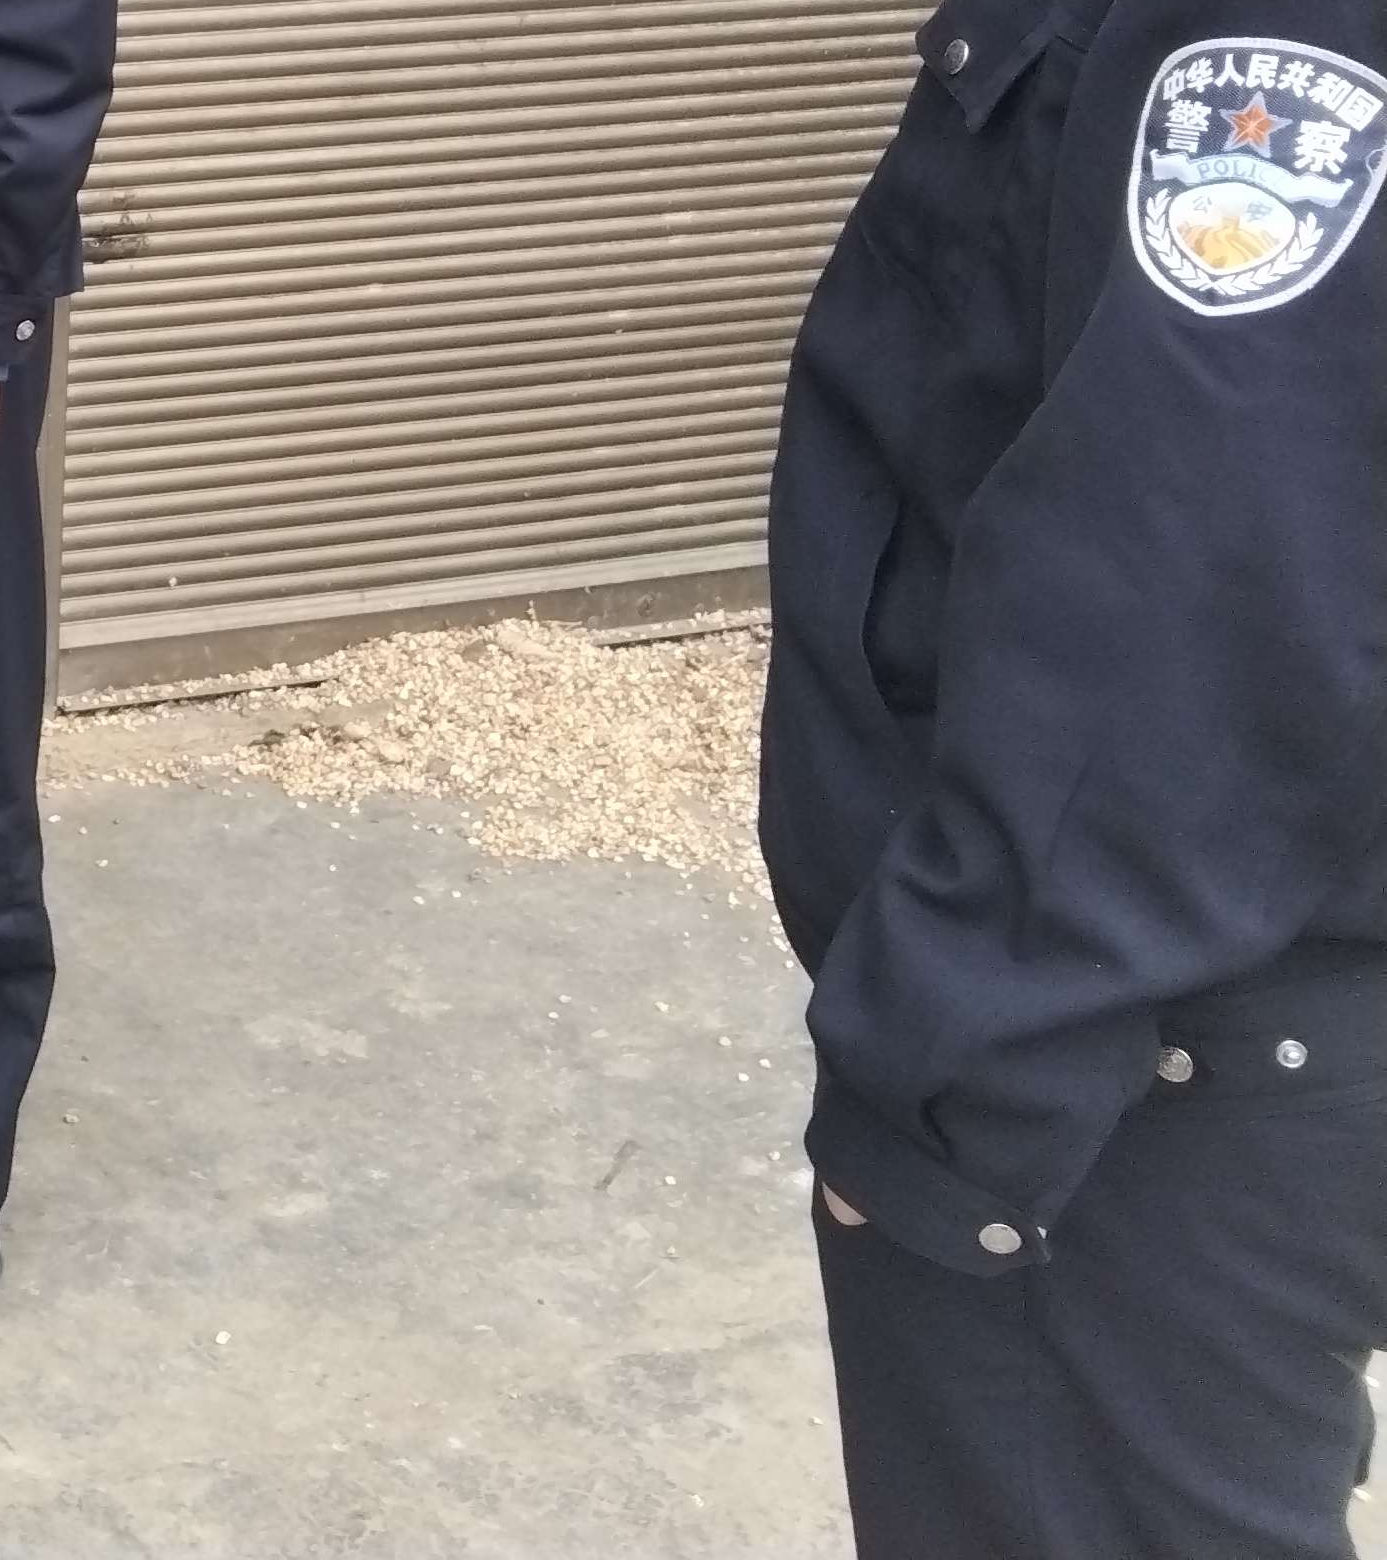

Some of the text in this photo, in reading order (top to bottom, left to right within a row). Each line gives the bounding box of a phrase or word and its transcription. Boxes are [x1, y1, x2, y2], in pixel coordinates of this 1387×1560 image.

[1163, 53, 1384, 132] 中华人民共和国
[1196, 159, 1277, 184] POLIC
